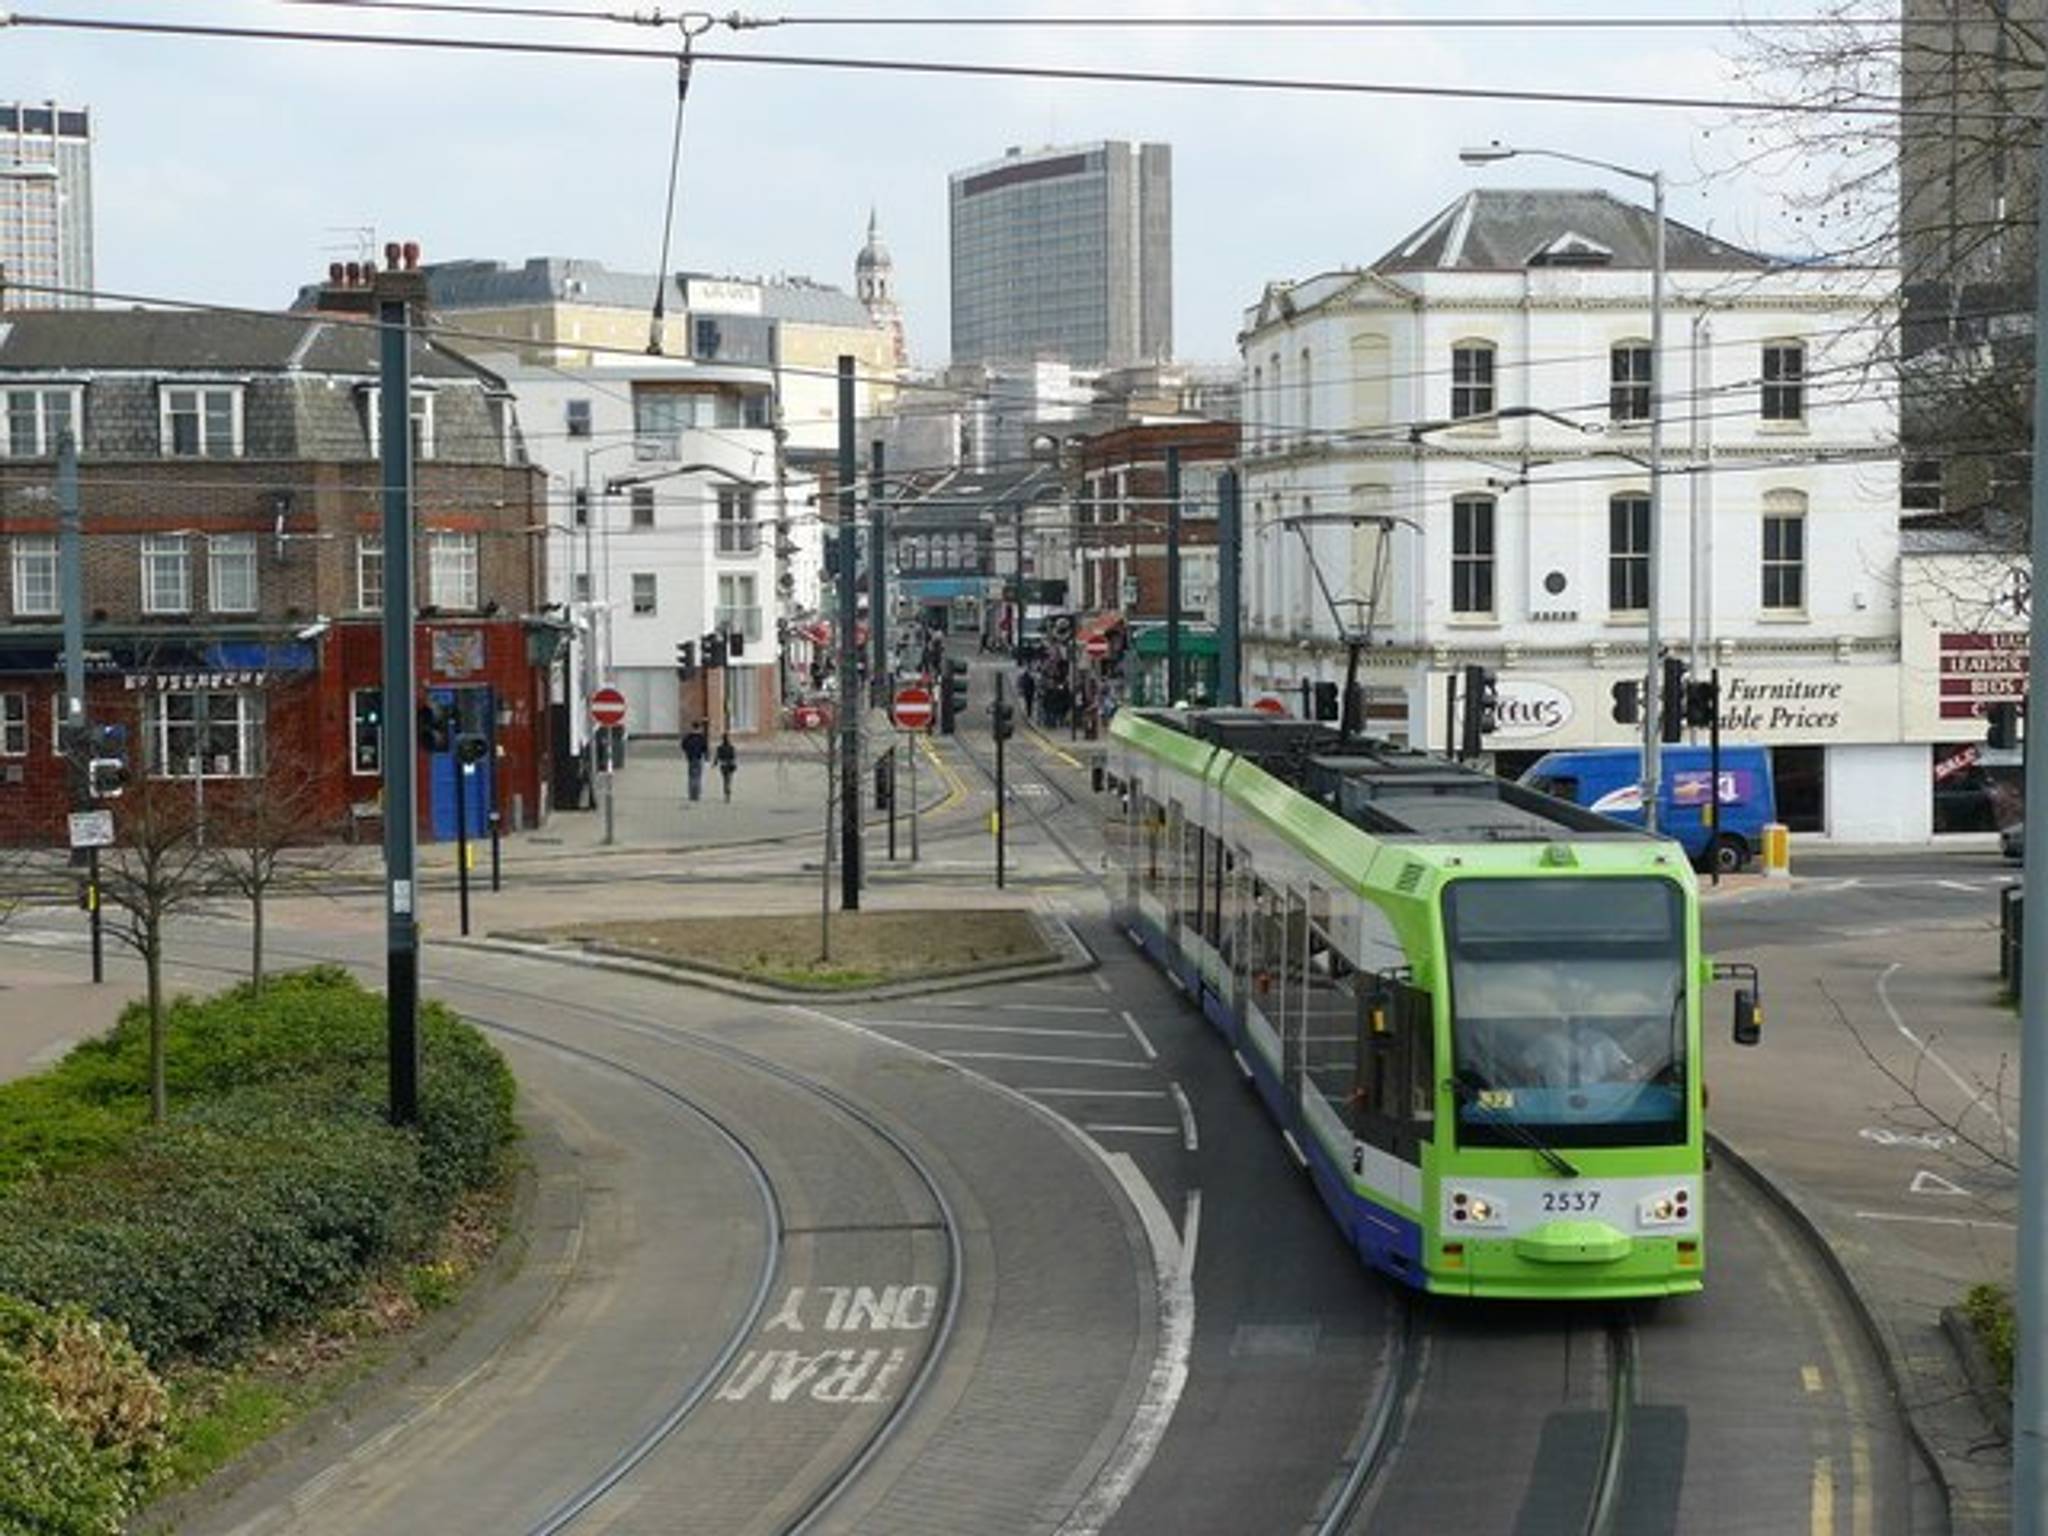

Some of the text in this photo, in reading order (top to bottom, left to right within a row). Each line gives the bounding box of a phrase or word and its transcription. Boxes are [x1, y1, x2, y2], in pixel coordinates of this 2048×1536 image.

[1727, 678, 1843, 701] Furniture
[1769, 707, 1840, 729] Prices
[1542, 1192, 1601, 1211] 2537
[761, 1284, 939, 1331] ONLY
